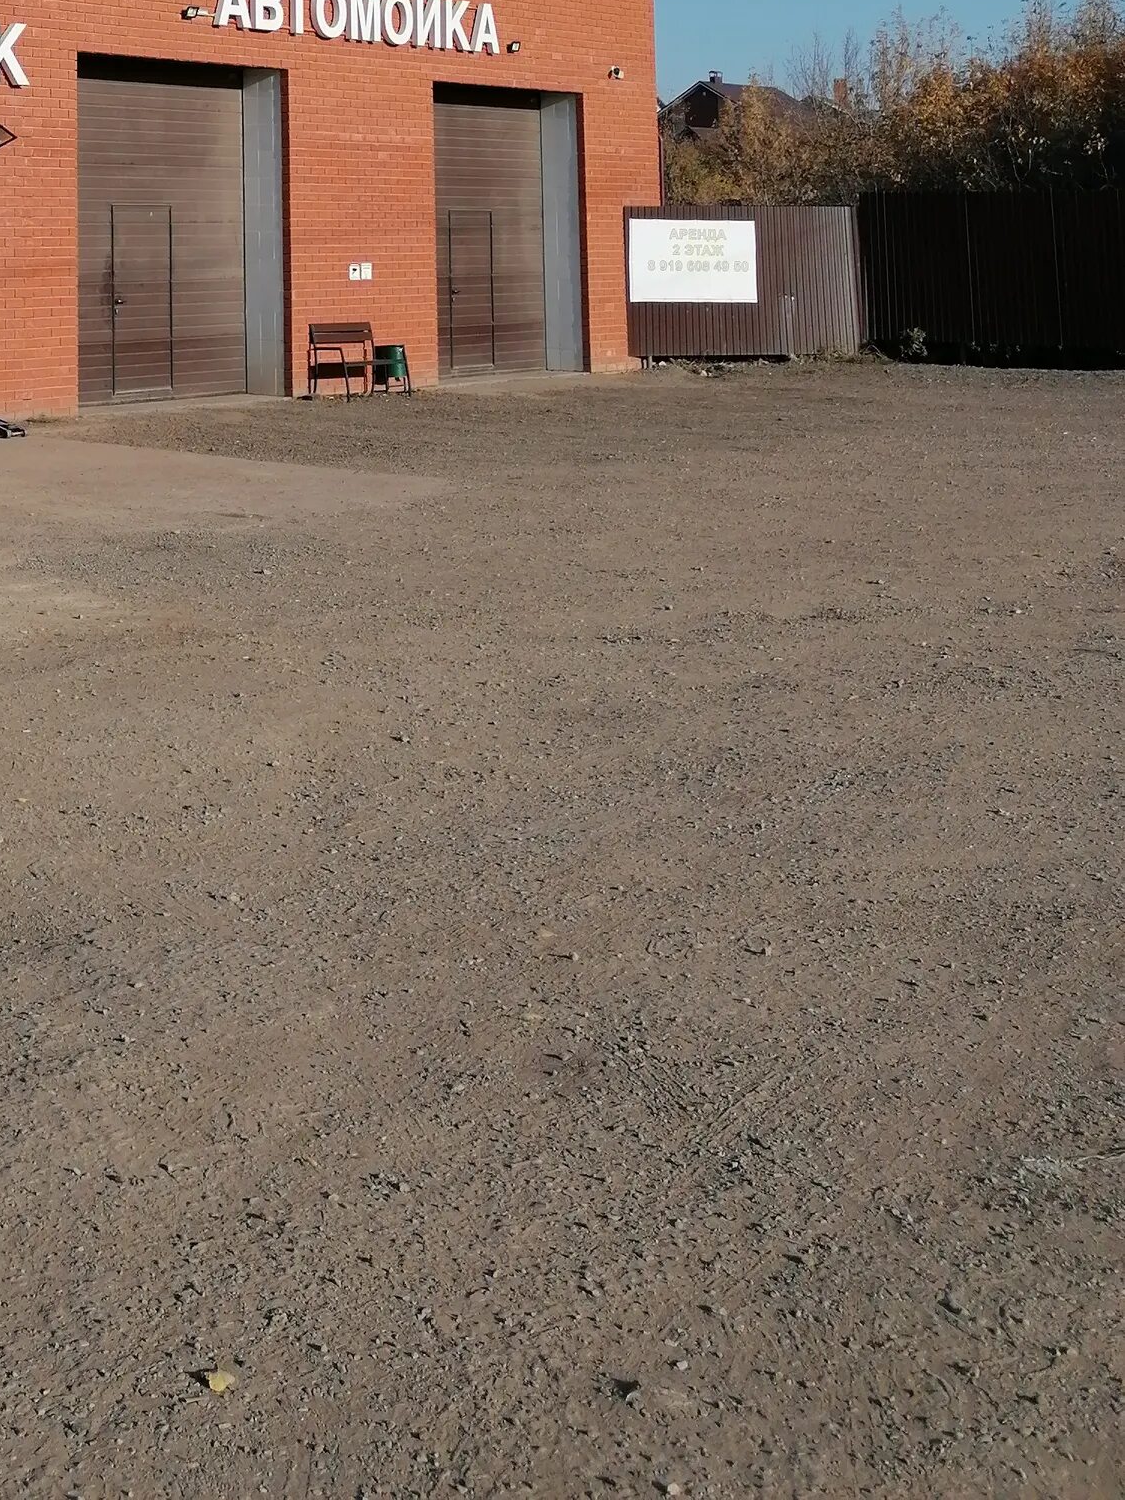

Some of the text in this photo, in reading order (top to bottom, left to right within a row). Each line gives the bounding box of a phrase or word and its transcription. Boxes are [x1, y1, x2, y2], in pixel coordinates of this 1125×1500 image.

[669, 228, 726, 241] АРЕНДА
[672, 244, 724, 256] 2 ЭТАЖ
[647, 260, 655, 271] 8
[659, 260, 683, 271] 919
